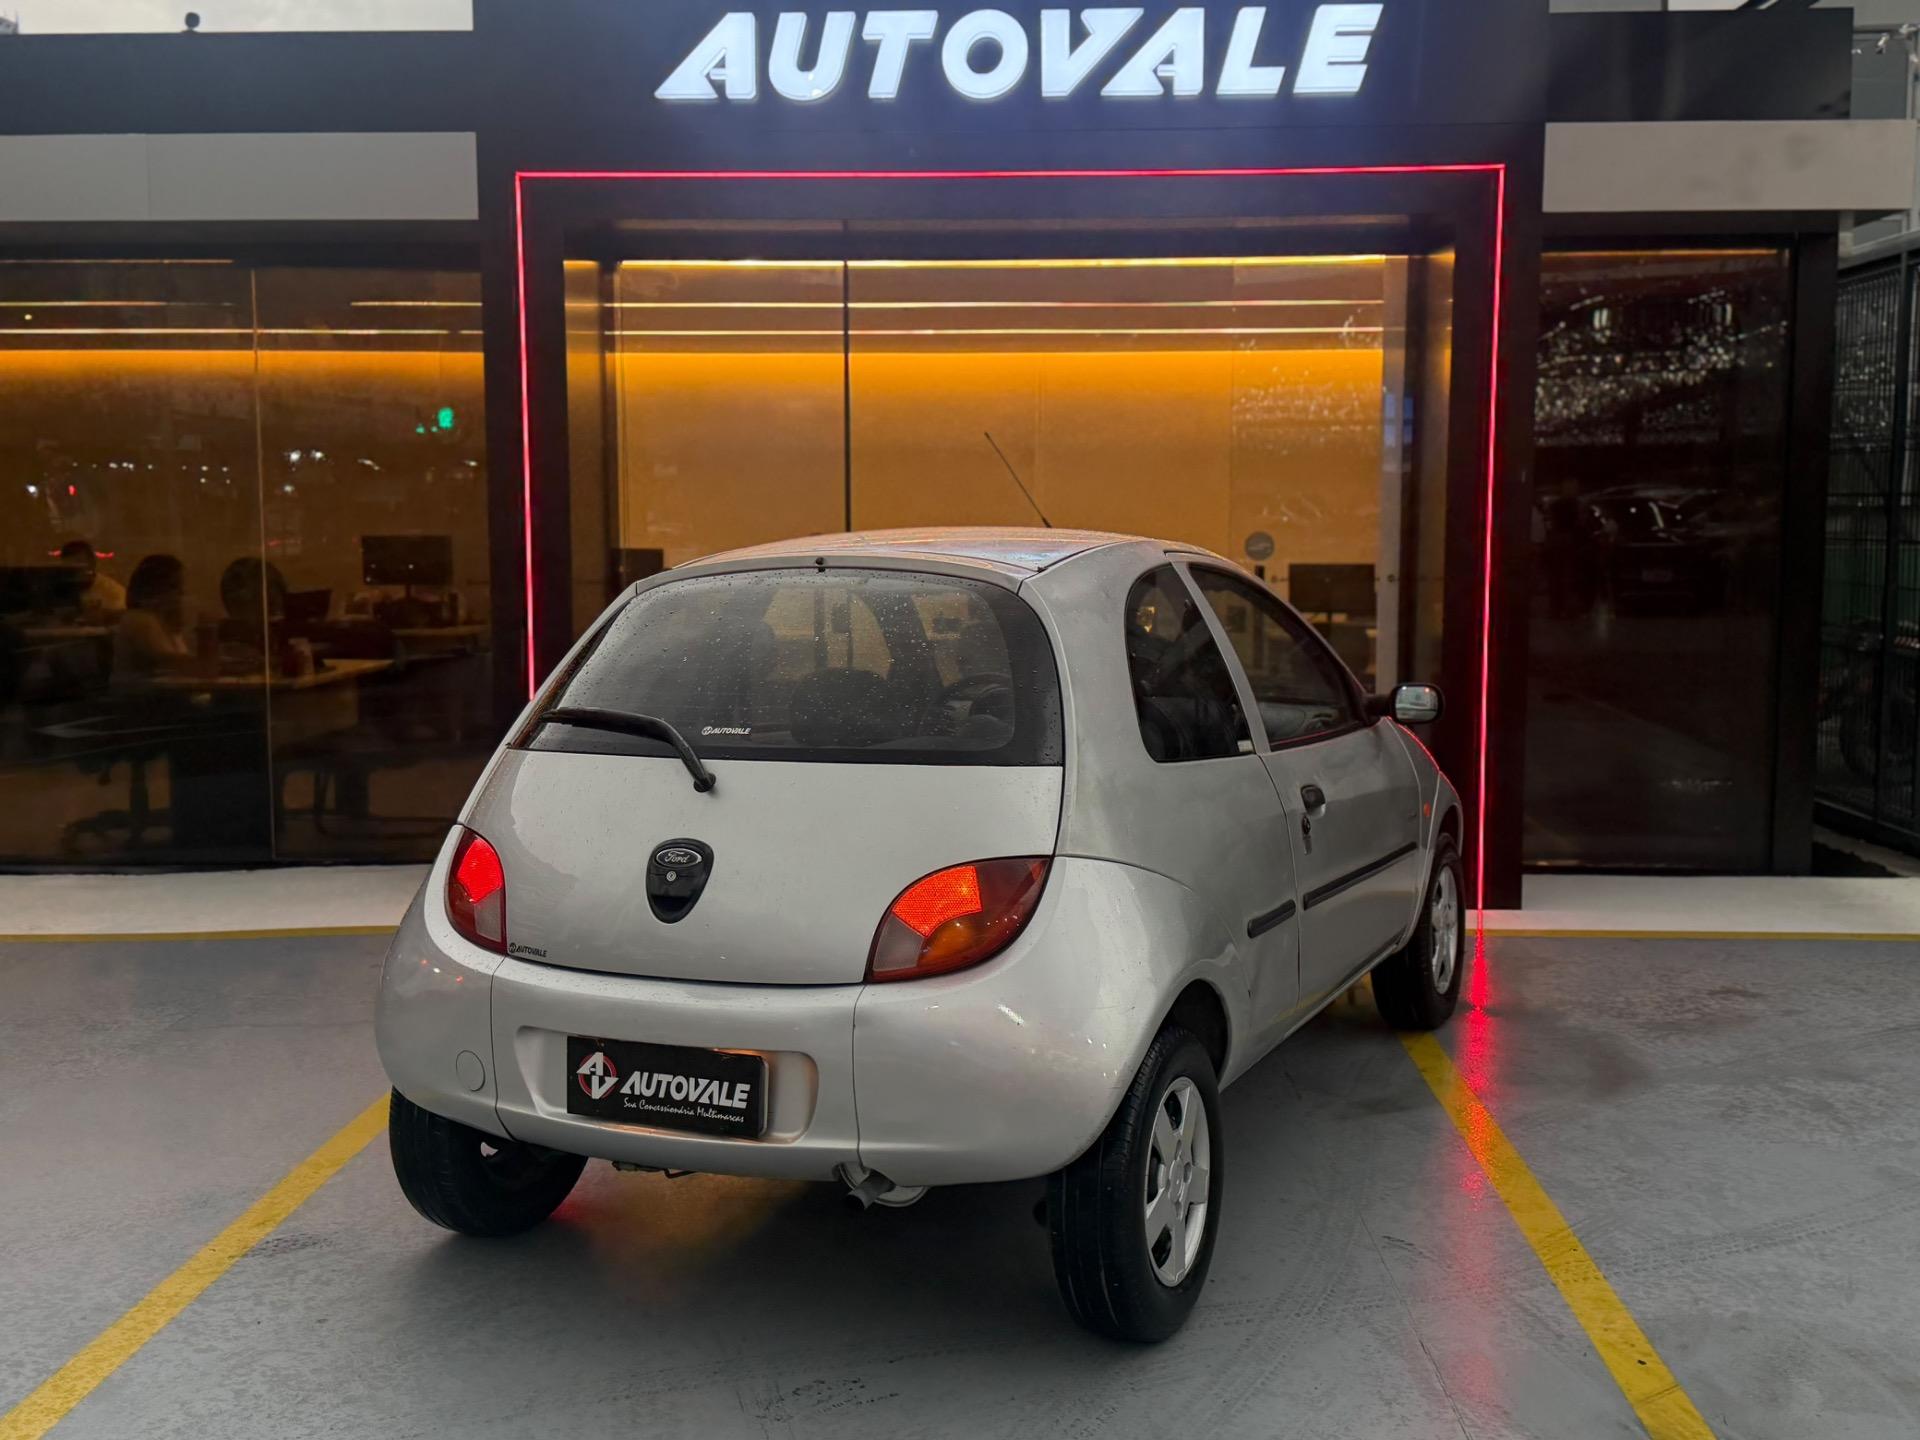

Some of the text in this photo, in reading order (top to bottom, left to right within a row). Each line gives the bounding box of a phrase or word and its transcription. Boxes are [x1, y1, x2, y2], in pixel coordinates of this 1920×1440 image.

[654, 3, 1385, 101] AUTOVALE
[665, 850, 690, 863] Ford
[620, 1070, 751, 1109] AUTOVALE
[623, 1097, 637, 1109] Sua
[697, 1106, 745, 1123] Multimarcas
